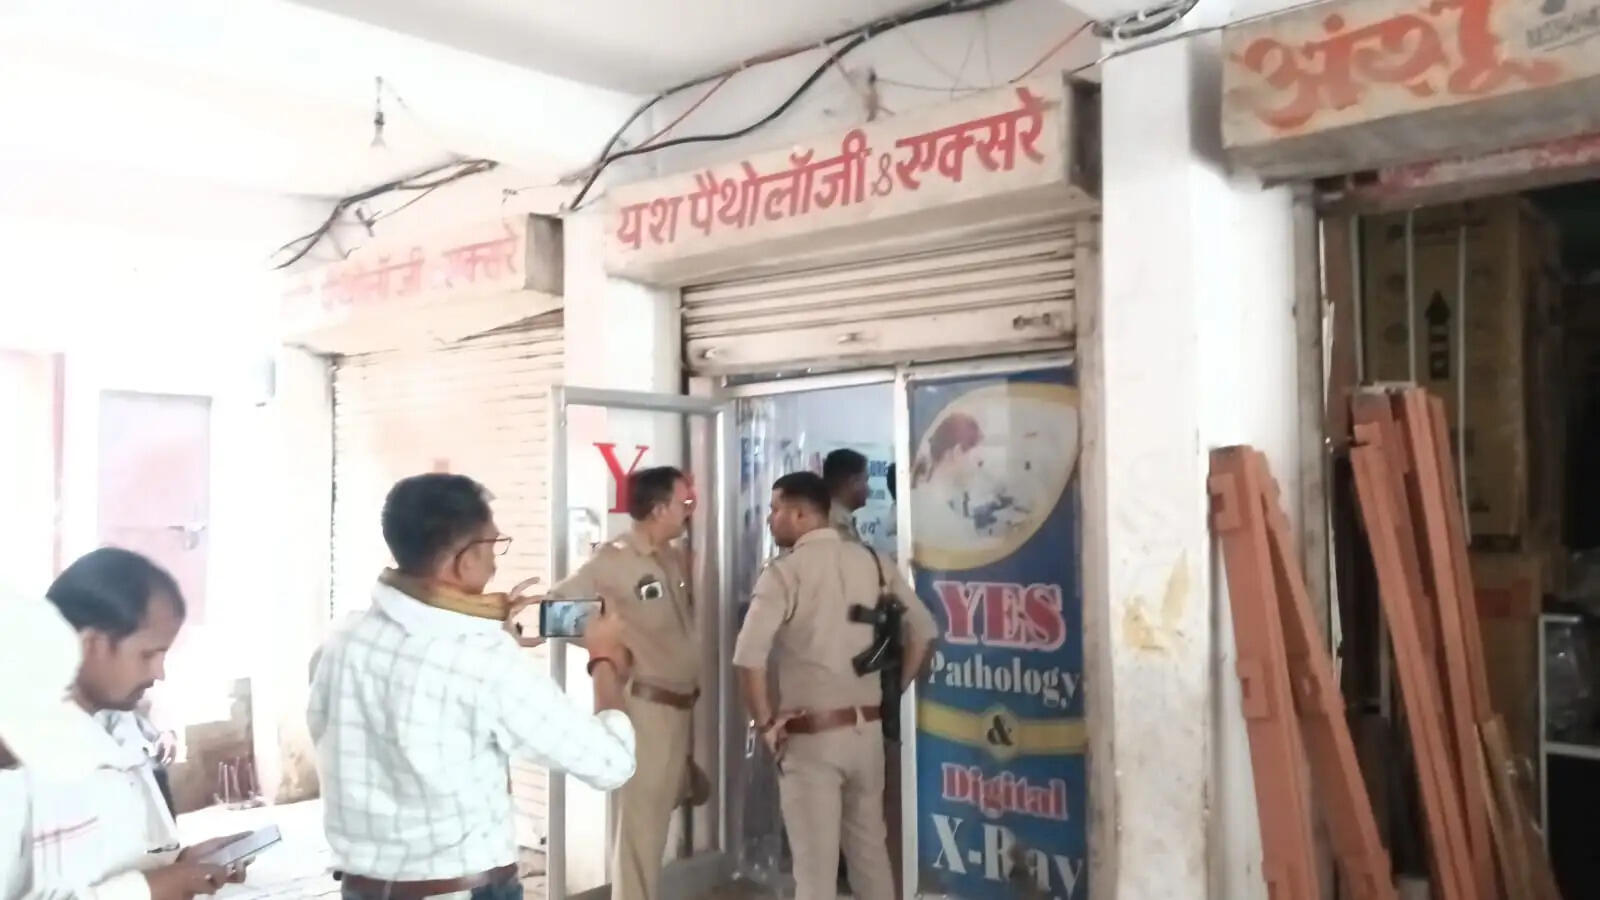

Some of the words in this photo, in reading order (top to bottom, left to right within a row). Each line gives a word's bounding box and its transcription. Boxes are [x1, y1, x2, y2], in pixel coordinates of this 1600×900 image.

[616, 197, 679, 250] यश
[690, 129, 872, 237] पैथोलॉजी
[895, 87, 1055, 190] एक्सरे
[932, 581, 1066, 652] YES
[928, 650, 1080, 709] Pathology
[987, 714, 1013, 746] &
[941, 762, 1069, 821] Digital
